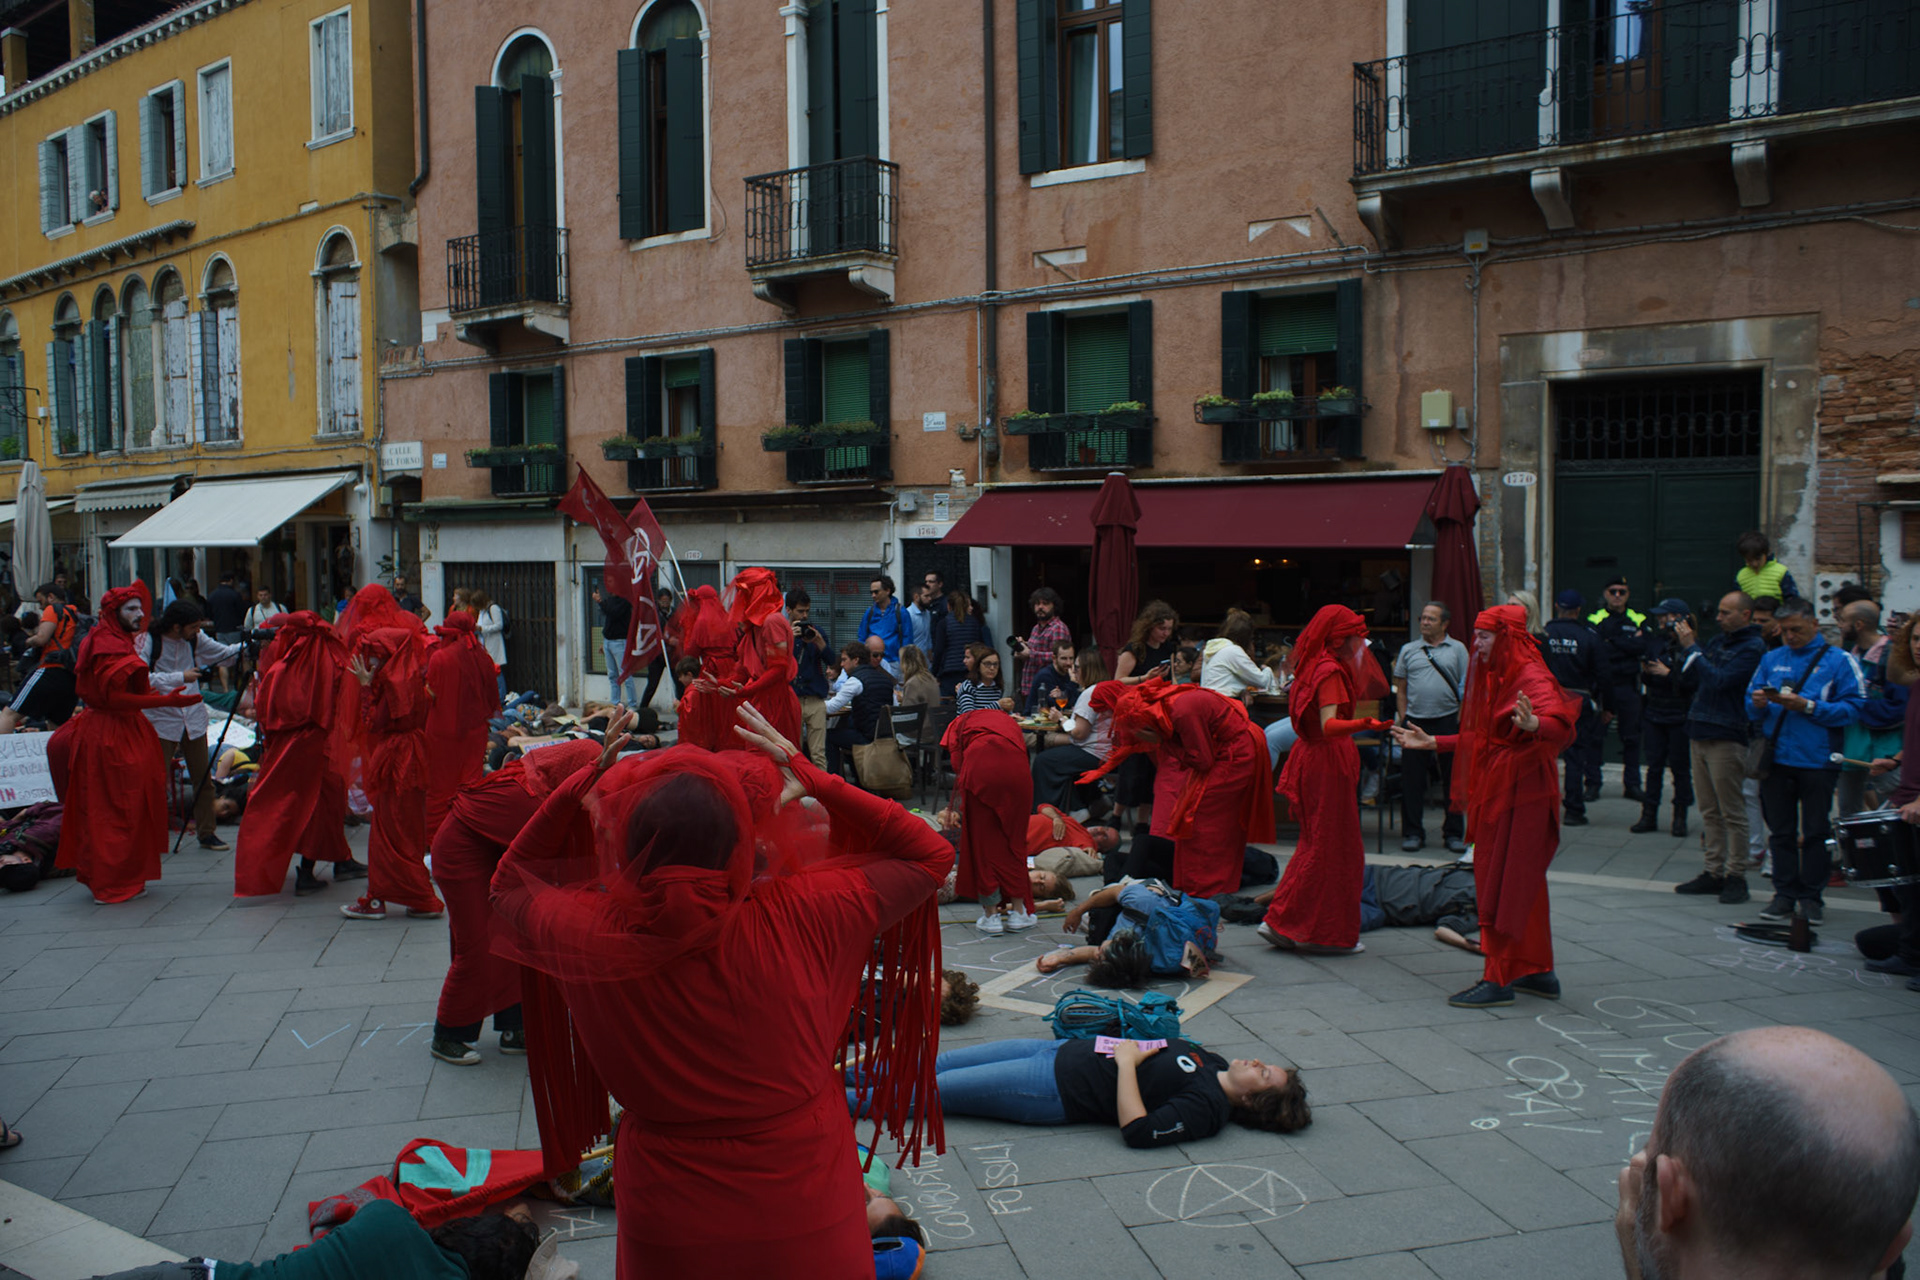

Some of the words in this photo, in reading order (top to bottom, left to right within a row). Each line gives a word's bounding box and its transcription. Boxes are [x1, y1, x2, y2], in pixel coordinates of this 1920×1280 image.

[389, 446, 412, 455] CALLE
[382, 457, 395, 466] DEL
[396, 457, 420, 465] FORNO
[1507, 474, 1533, 484] 1770
[969, 1143, 1032, 1216] FOSSILI
